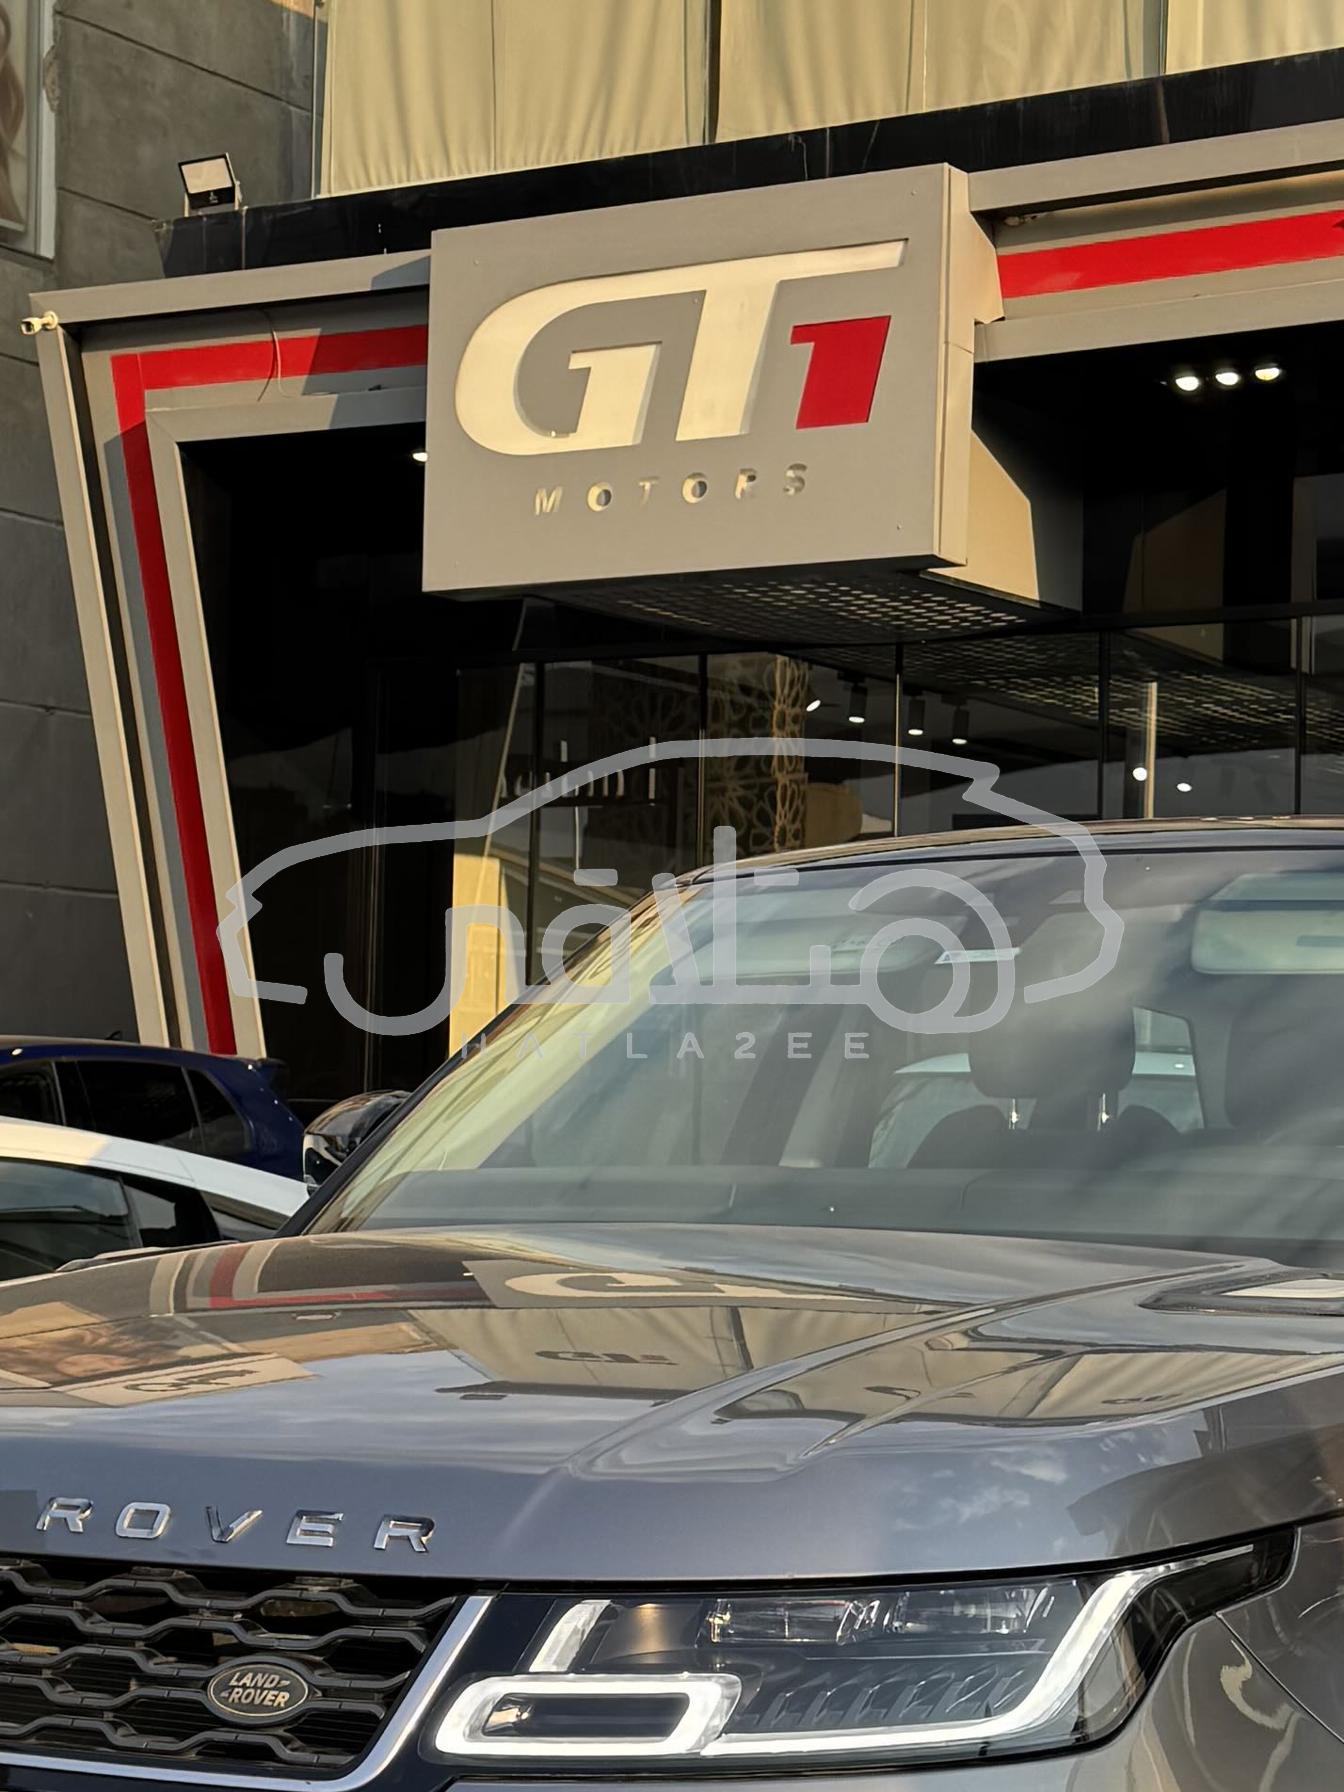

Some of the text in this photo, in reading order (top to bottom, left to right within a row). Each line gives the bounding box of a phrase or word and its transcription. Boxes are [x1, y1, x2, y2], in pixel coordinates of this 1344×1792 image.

[533, 462, 809, 516] MOTORS
[34, 1496, 438, 1554] ROVER
[228, 1672, 280, 1688] LAND
[228, 1688, 291, 1708] ROVER
